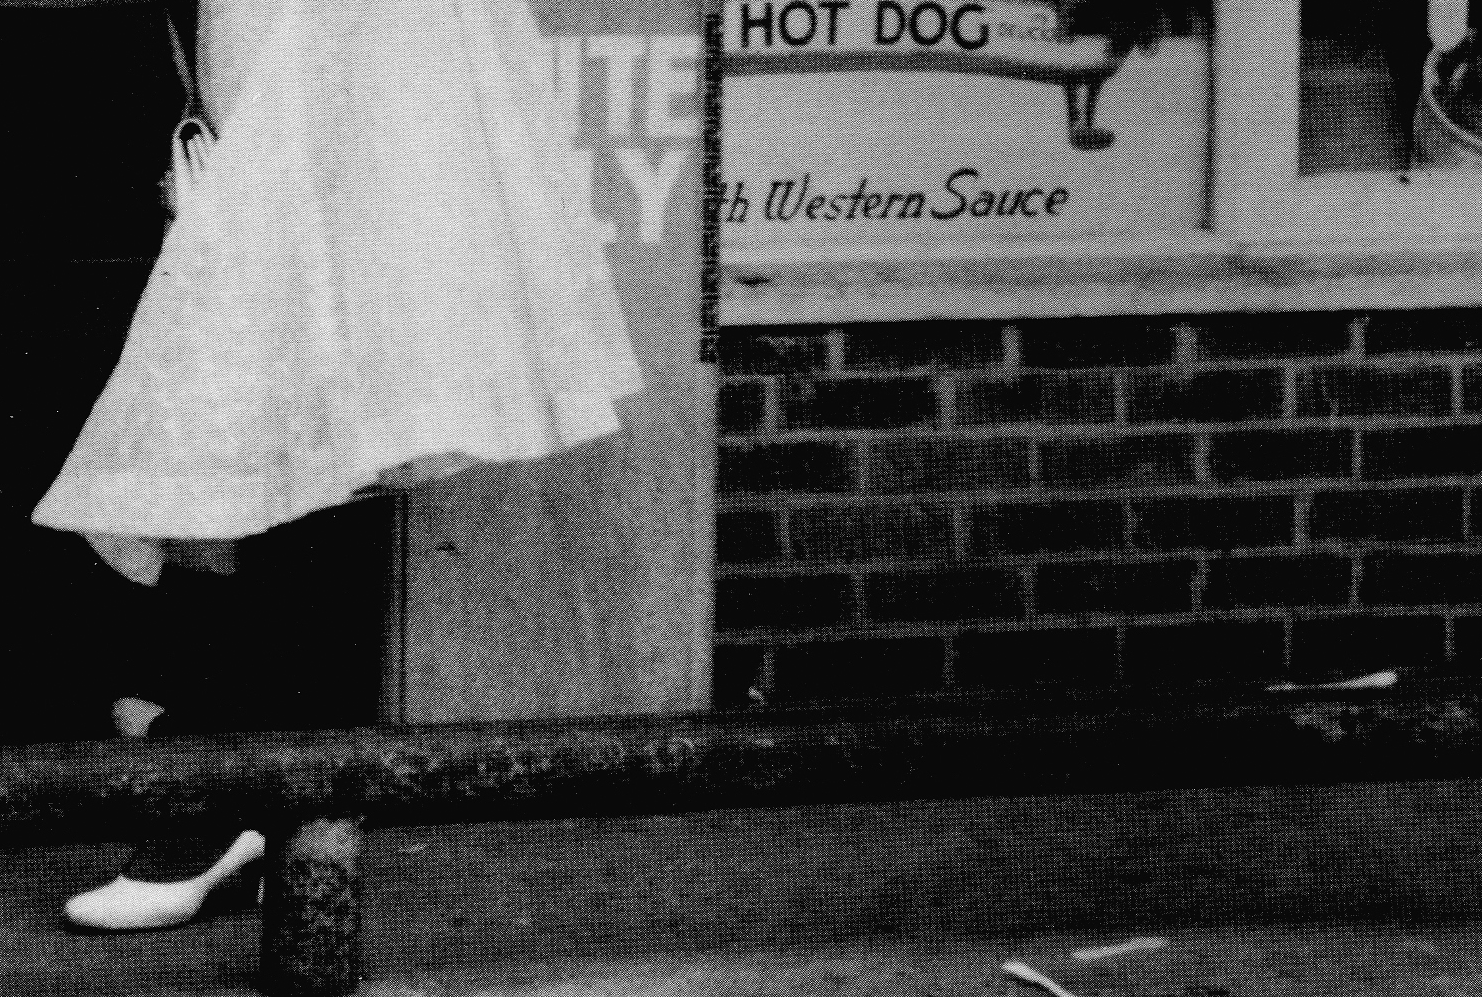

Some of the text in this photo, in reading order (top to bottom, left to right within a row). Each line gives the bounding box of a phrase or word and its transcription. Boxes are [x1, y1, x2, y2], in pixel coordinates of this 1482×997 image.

[741, 1, 850, 49] HOT
[875, 1, 990, 50] DOG
[559, 34, 702, 137] ITE
[570, 147, 690, 244] LY
[720, 167, 1070, 223] th Western Sauce
